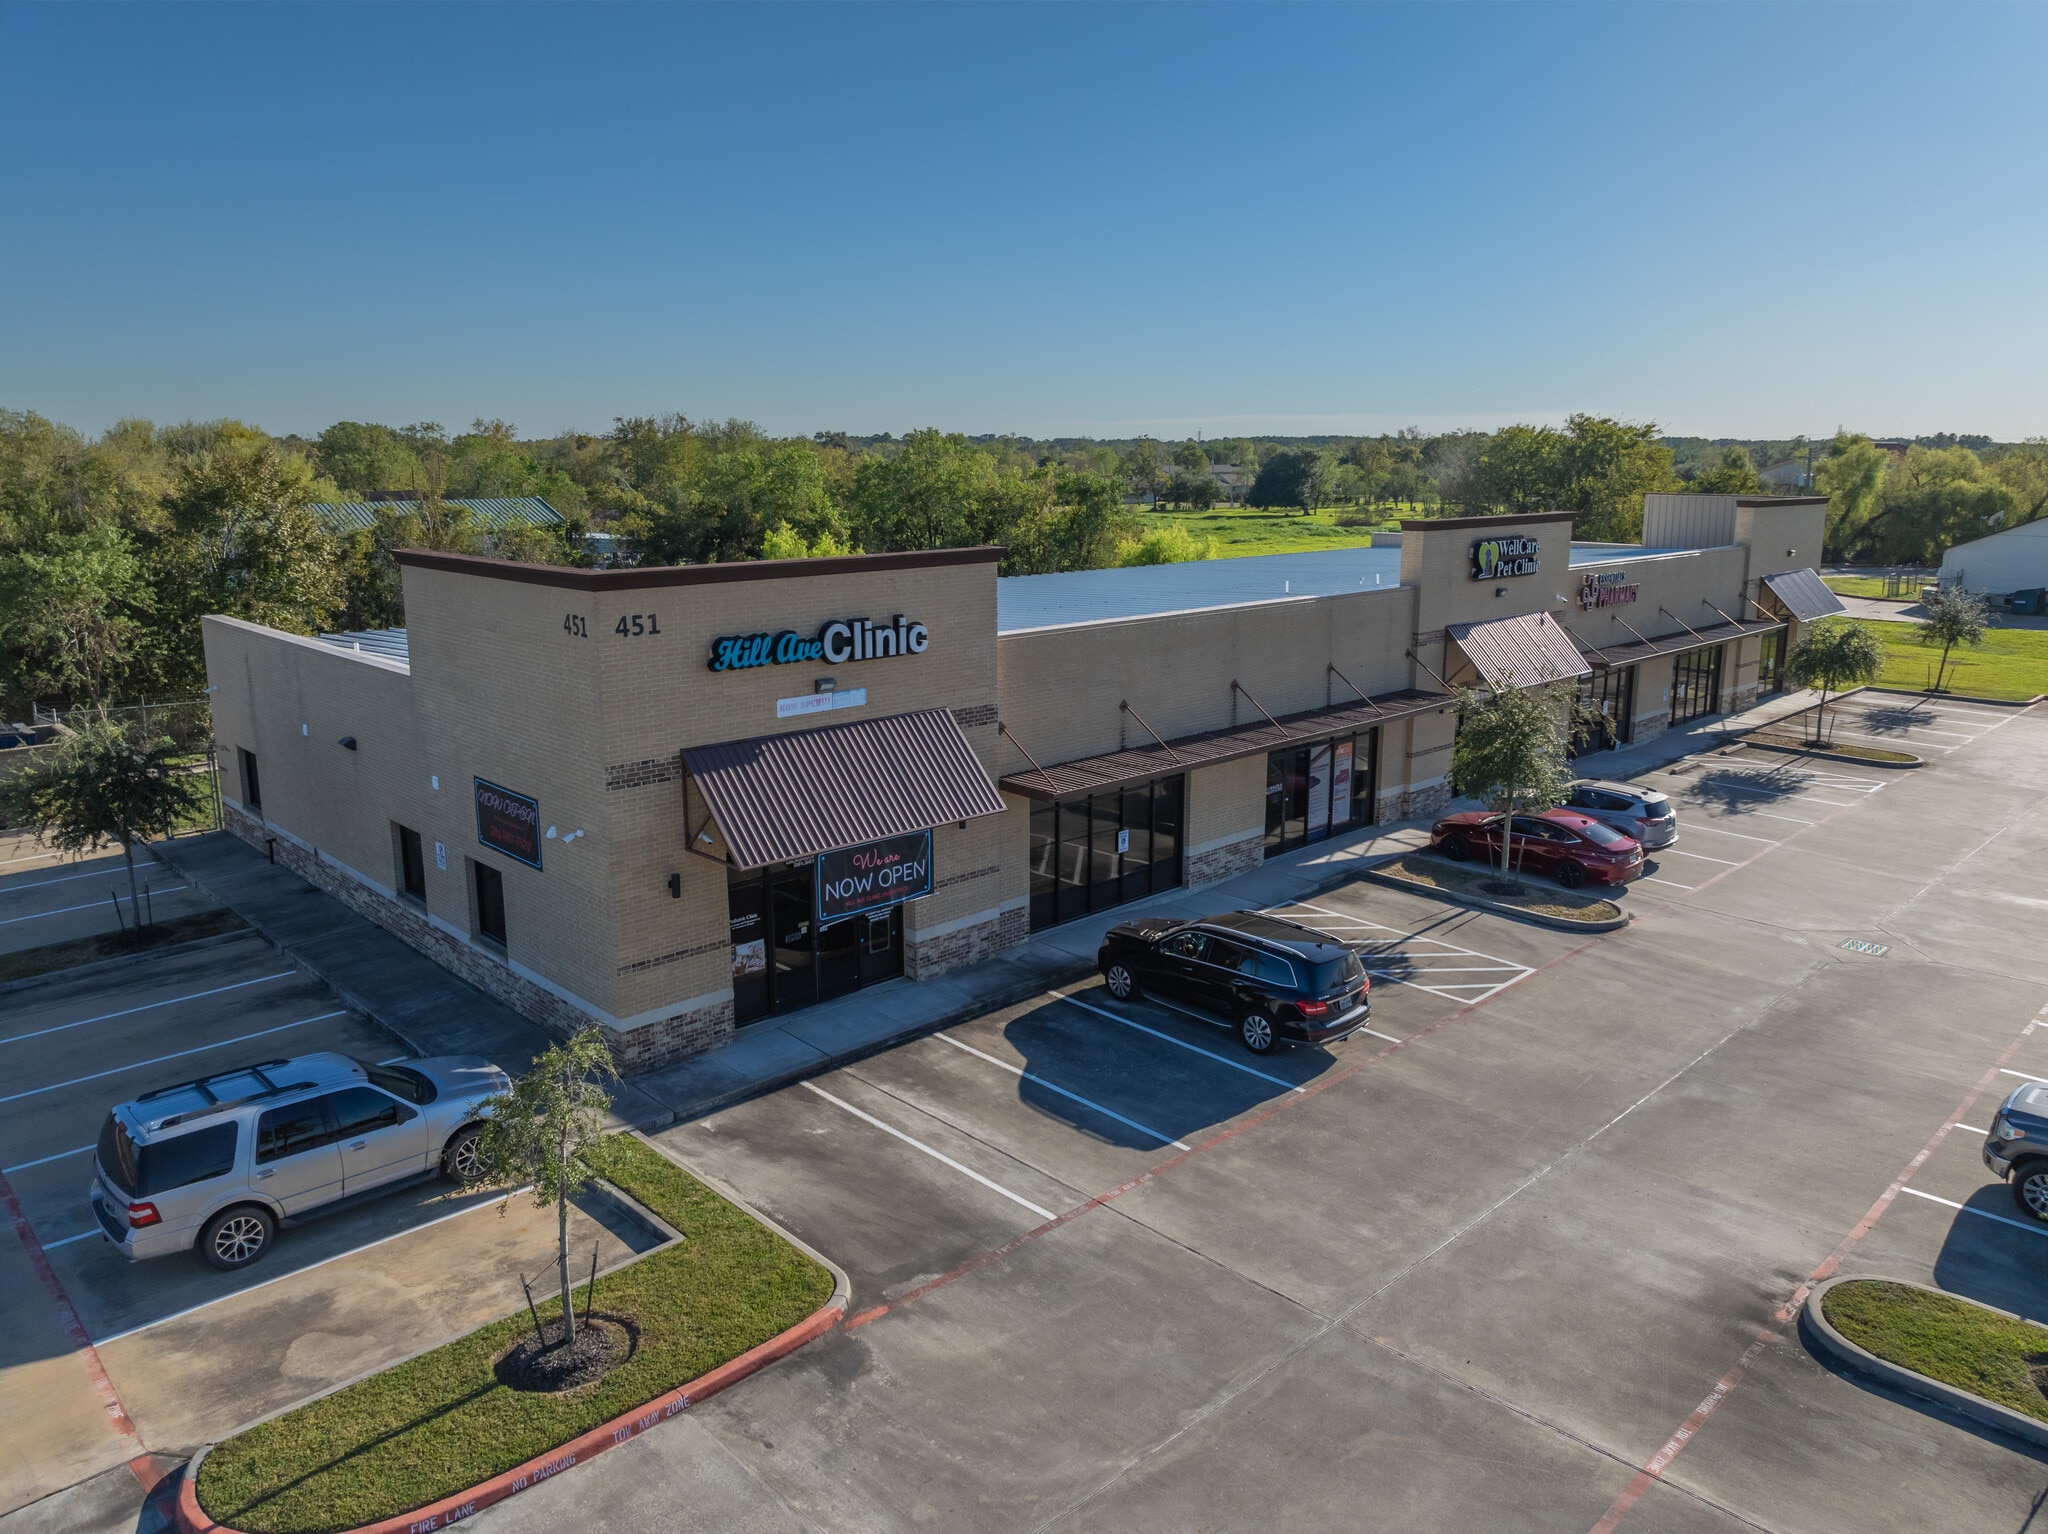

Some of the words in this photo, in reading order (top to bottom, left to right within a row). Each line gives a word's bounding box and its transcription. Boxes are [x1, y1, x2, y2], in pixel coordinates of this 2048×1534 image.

[1498, 538, 1539, 555] WellCare
[1498, 561, 1512, 576] Pet
[1515, 557, 1539, 574] Clinic
[1599, 583, 1640, 608] PHARMACY
[563, 613, 588, 639] 451
[615, 613, 661, 638] 451
[716, 636, 772, 670] Hill
[776, 633, 823, 665] Ave
[822, 616, 929, 664] Clinic
[852, 848, 883, 870] We
[884, 853, 901, 864] are
[825, 872, 873, 901] NOW
[878, 859, 926, 887] OPEN
[410, 1515, 439, 1534] FIRE
[446, 1501, 476, 1523] LANE
[512, 1477, 527, 1493] NO
[533, 1453, 576, 1481] PARKING
[612, 1426, 632, 1443] TOW
[638, 1410, 661, 1429] AWAY
[665, 1395, 690, 1416] ZONE
